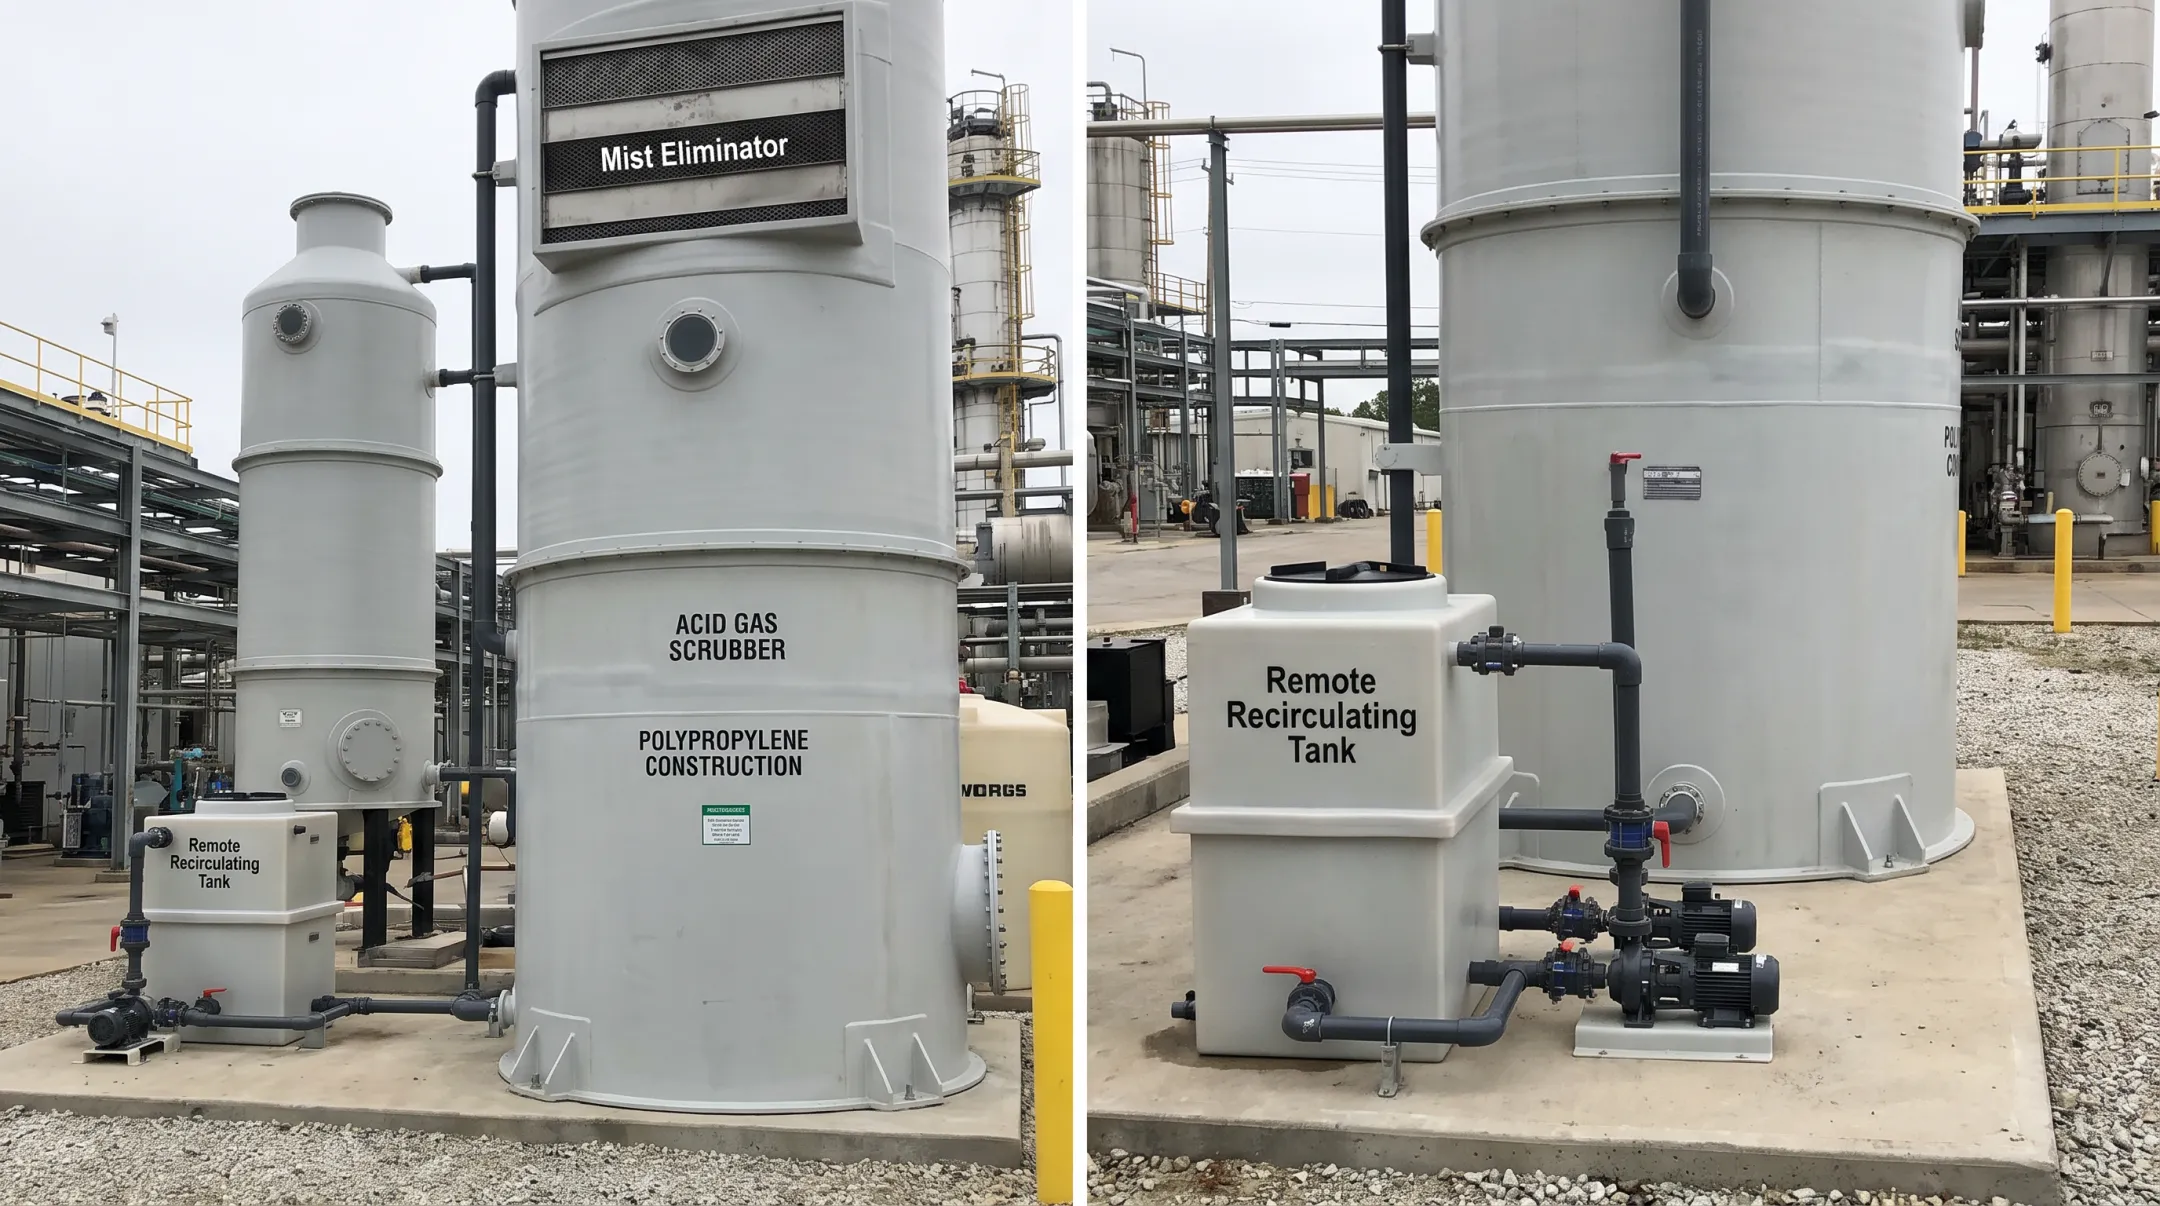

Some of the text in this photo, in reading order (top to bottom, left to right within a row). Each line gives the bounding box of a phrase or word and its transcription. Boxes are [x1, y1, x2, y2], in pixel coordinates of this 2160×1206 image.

[601, 136, 789, 172] Mist Eliminator
[675, 613, 778, 635] ACID GAS
[669, 638, 786, 661] SCRUBBER
[1267, 665, 1376, 694] Remote
[1227, 700, 1417, 738] Recirculating
[639, 729, 809, 751] POLYPROPYLENE
[1287, 735, 1357, 764] Tank
[645, 755, 802, 777] CONSTRUCTION
[188, 837, 241, 853] Remote
[170, 855, 260, 875] Recirculating
[198, 873, 231, 889] Tank
